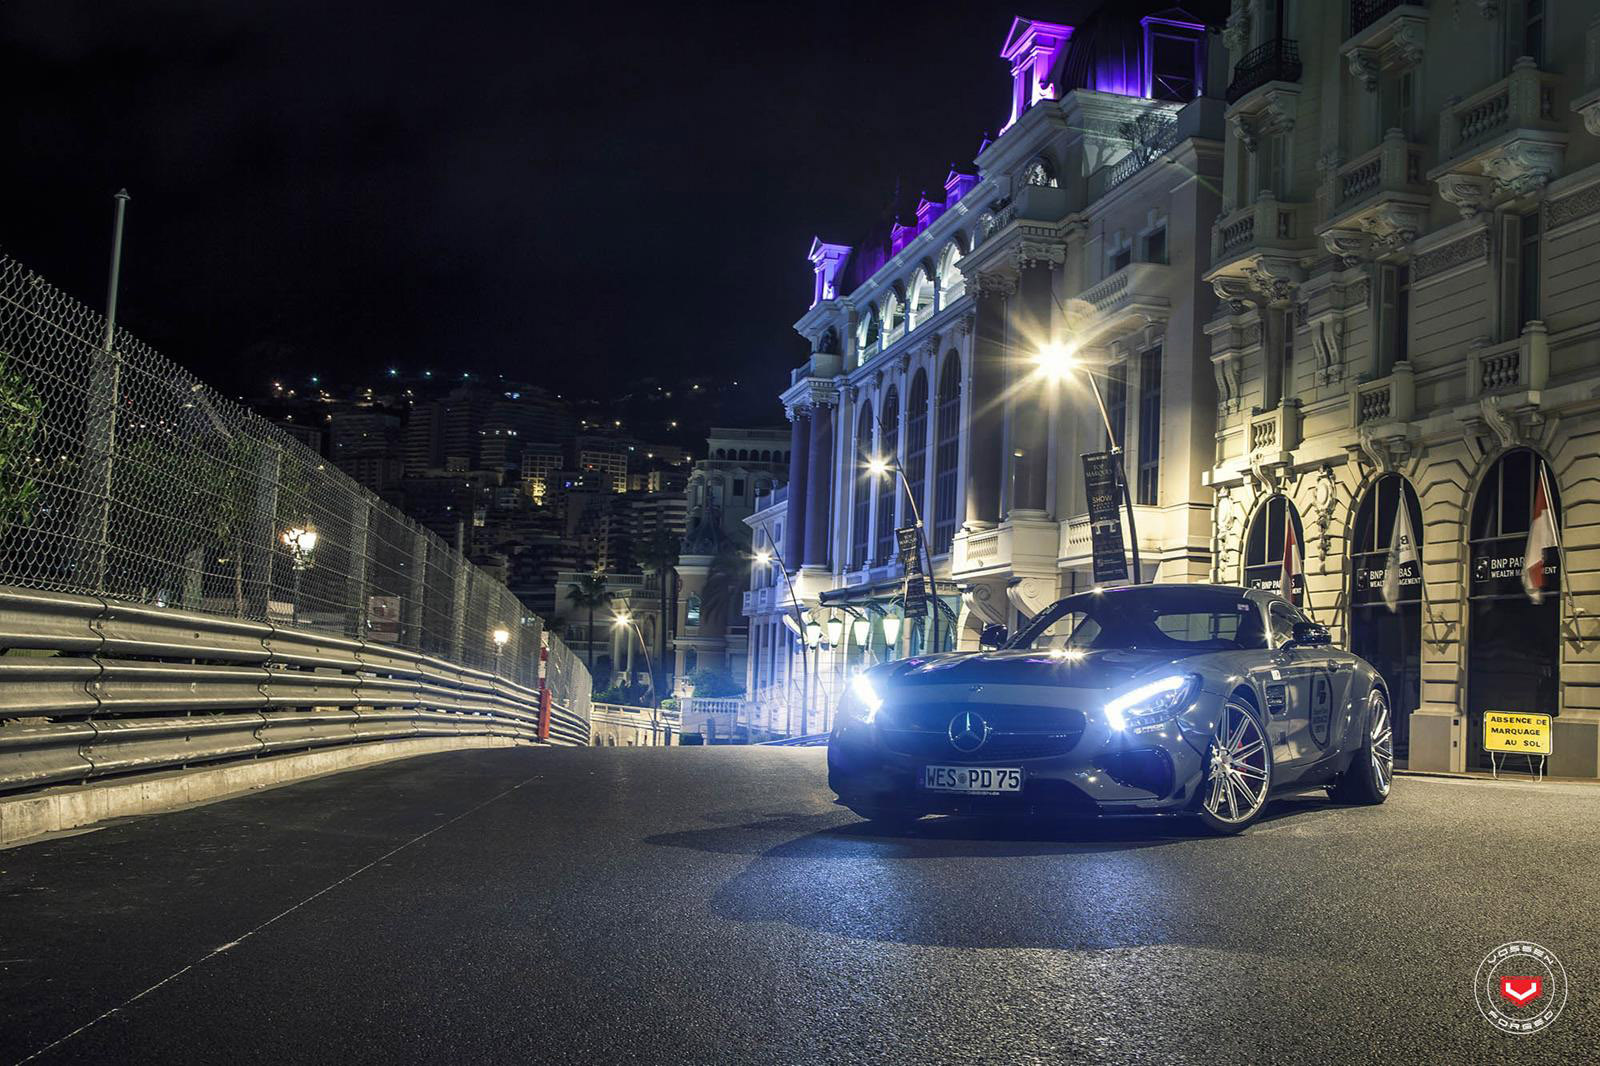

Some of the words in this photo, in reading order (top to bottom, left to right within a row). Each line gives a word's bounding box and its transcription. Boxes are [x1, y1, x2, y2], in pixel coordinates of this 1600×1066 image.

[1491, 558, 1508, 569] BNP
[1369, 570, 1383, 580] BNP
[1491, 569, 1514, 578] WEALTH
[1261, 580, 1272, 590] BNP
[1491, 716, 1532, 724] ABSENCE
[1491, 727, 1541, 736] MARQUAGE
[927, 768, 957, 787] WES
[968, 769, 993, 788] PD
[996, 770, 1020, 789] 75
